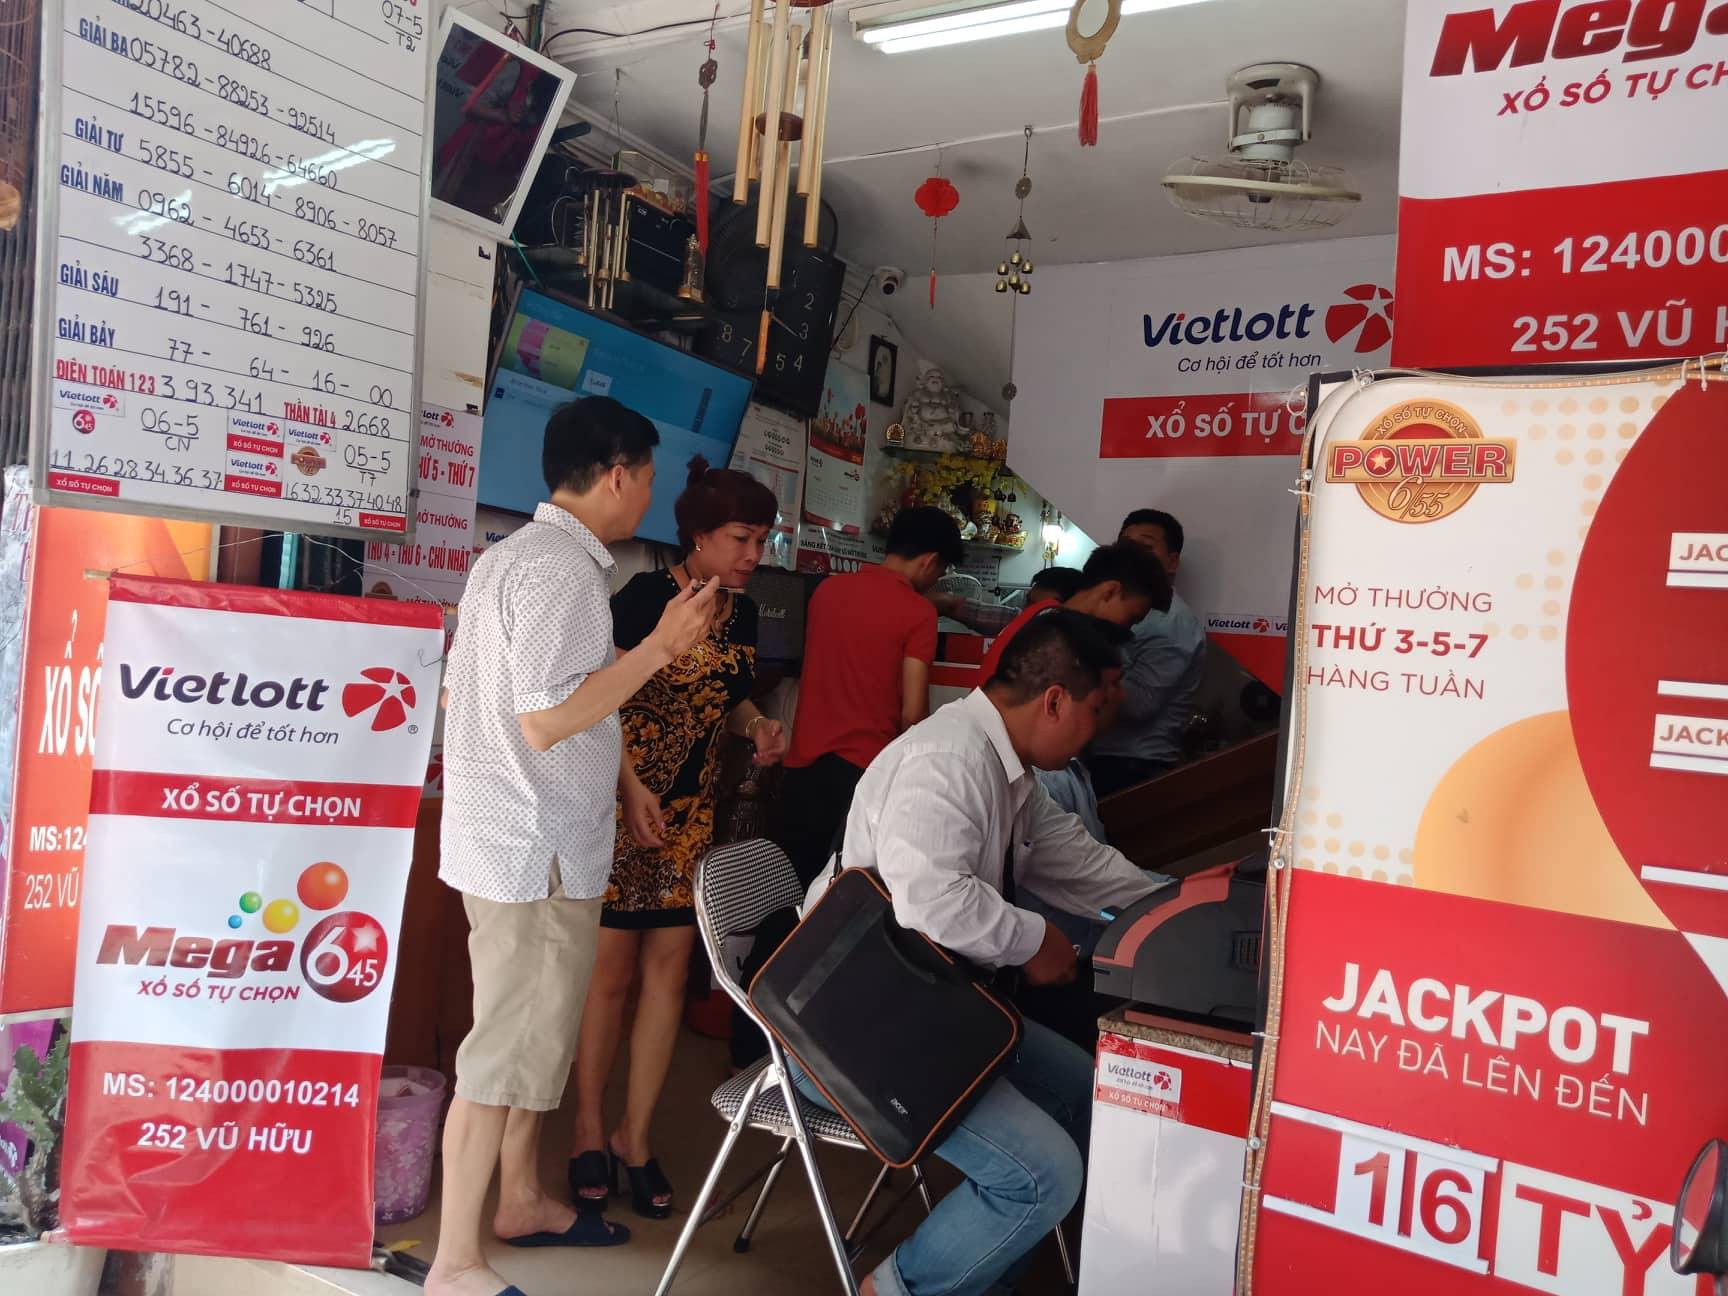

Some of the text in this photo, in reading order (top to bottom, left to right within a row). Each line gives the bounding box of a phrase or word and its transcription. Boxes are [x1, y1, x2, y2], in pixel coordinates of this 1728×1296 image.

[79, 15, 128, 57] GIẢI BA
[217, 29, 271, 71] 40688
[130, 38, 200, 88] 05782
[217, 74, 269, 116] 88253
[1496, 76, 1550, 116] XỔ
[1559, 68, 1612, 107] SỐ
[1625, 67, 1679, 101] TỰ
[75, 115, 124, 153] GIẢI TƯ
[129, 92, 338, 189] 15596 84926 64660
[60, 161, 124, 202] GIẢI NĂM
[140, 139, 397, 248] 5855 6014 8906 8057
[138, 189, 337, 272] 0962 4653 6361
[60, 259, 119, 297] GIẢI SÁU
[139, 234, 337, 314] 3368 1747 5325
[1442, 242, 1532, 282] MS:
[58, 314, 116, 347] GIẢI BẢY
[153, 286, 335, 353] 191 761 926
[1143, 302, 1316, 348] Vietlott
[1511, 312, 1600, 352] 252
[1616, 298, 1692, 348] VŨ
[91, 364, 125, 390] TOÁN
[168, 338, 393, 407] 77 64 16 00
[1177, 350, 1321, 375] Cơ hội để tốt hơn
[59, 390, 101, 403] Vietlott
[313, 404, 328, 427] TÀI
[140, 407, 199, 436] 06-5
[232, 418, 265, 430] Vietlott
[288, 428, 319, 440] Vietlott
[342, 410, 390, 439] 2668
[1145, 399, 1281, 444] XỔ SỐ TỰ
[165, 436, 191, 451] CN
[344, 444, 391, 471] 05-5
[1332, 444, 1508, 478] POWER
[231, 458, 264, 471] Vietlott
[1314, 582, 1493, 613] MỞ THƯỞNG
[1208, 618, 1251, 629] Vietlott
[1311, 622, 1489, 659] THỨ 3-5-7
[37, 608, 79, 756] XỔ
[119, 663, 330, 712] Vietlott
[1307, 663, 1485, 701] HÀNG TUẦN
[167, 718, 339, 745] Cơ hội để tốt hơn
[161, 782, 361, 823] XỔ SỐ TỰ CHỌN
[24, 866, 80, 910] 252 VŨ
[96, 924, 295, 979] Mega
[137, 975, 301, 1004] XỔ SỐ TỰ CHỌN
[1321, 961, 1650, 1075] JACKPOT
[102, 1072, 359, 1108] MS: 124000010214
[1107, 1062, 1152, 1082] Vietlott
[1315, 1020, 1649, 1126] NAY ĐÃ LÊN ĐẾN
[137, 1121, 313, 1155] 252 VŨ HỮU
[1515, 1183, 1675, 1296] TỶ
